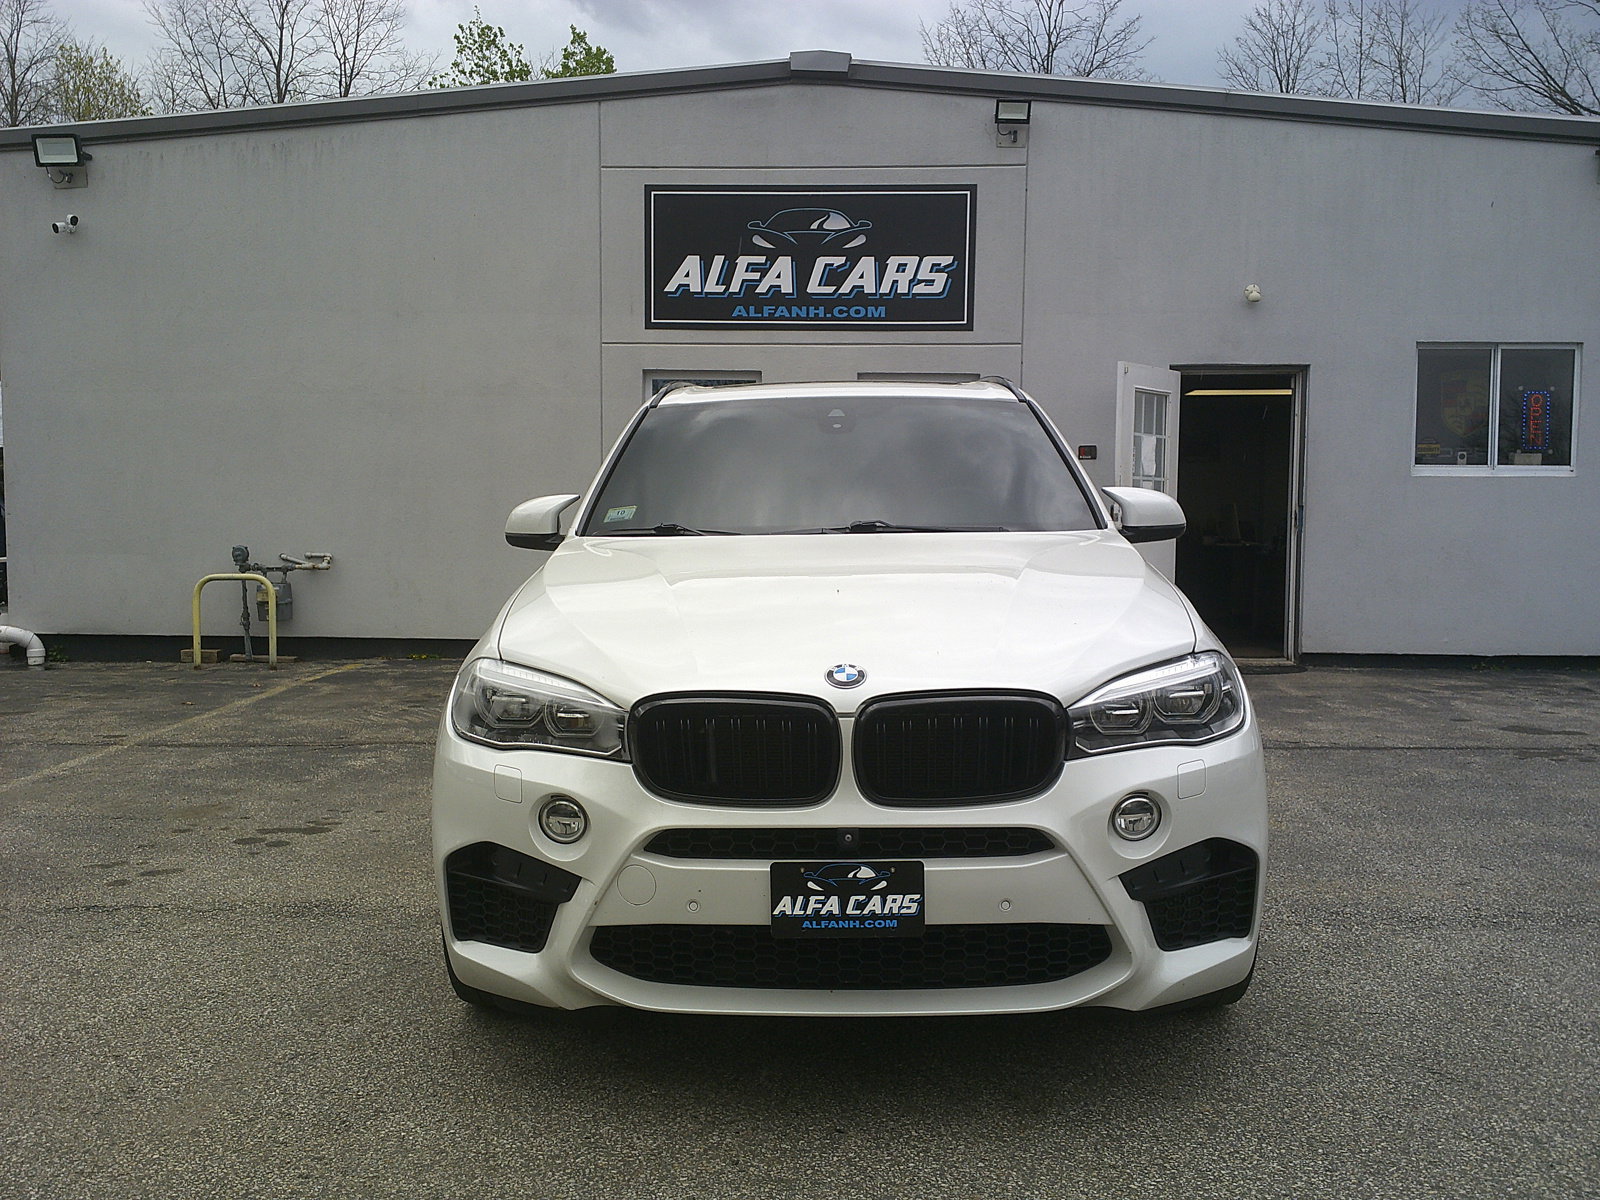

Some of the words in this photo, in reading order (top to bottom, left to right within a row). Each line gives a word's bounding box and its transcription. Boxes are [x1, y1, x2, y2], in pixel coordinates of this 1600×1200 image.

[664, 255, 797, 298] ALFA
[806, 255, 958, 298] CARS
[731, 305, 886, 318] ALFANH.COM
[1530, 394, 1542, 446] OPEN
[772, 895, 841, 917] ALFA
[845, 894, 923, 917] CARS
[802, 919, 898, 929] ALFANH.COM
